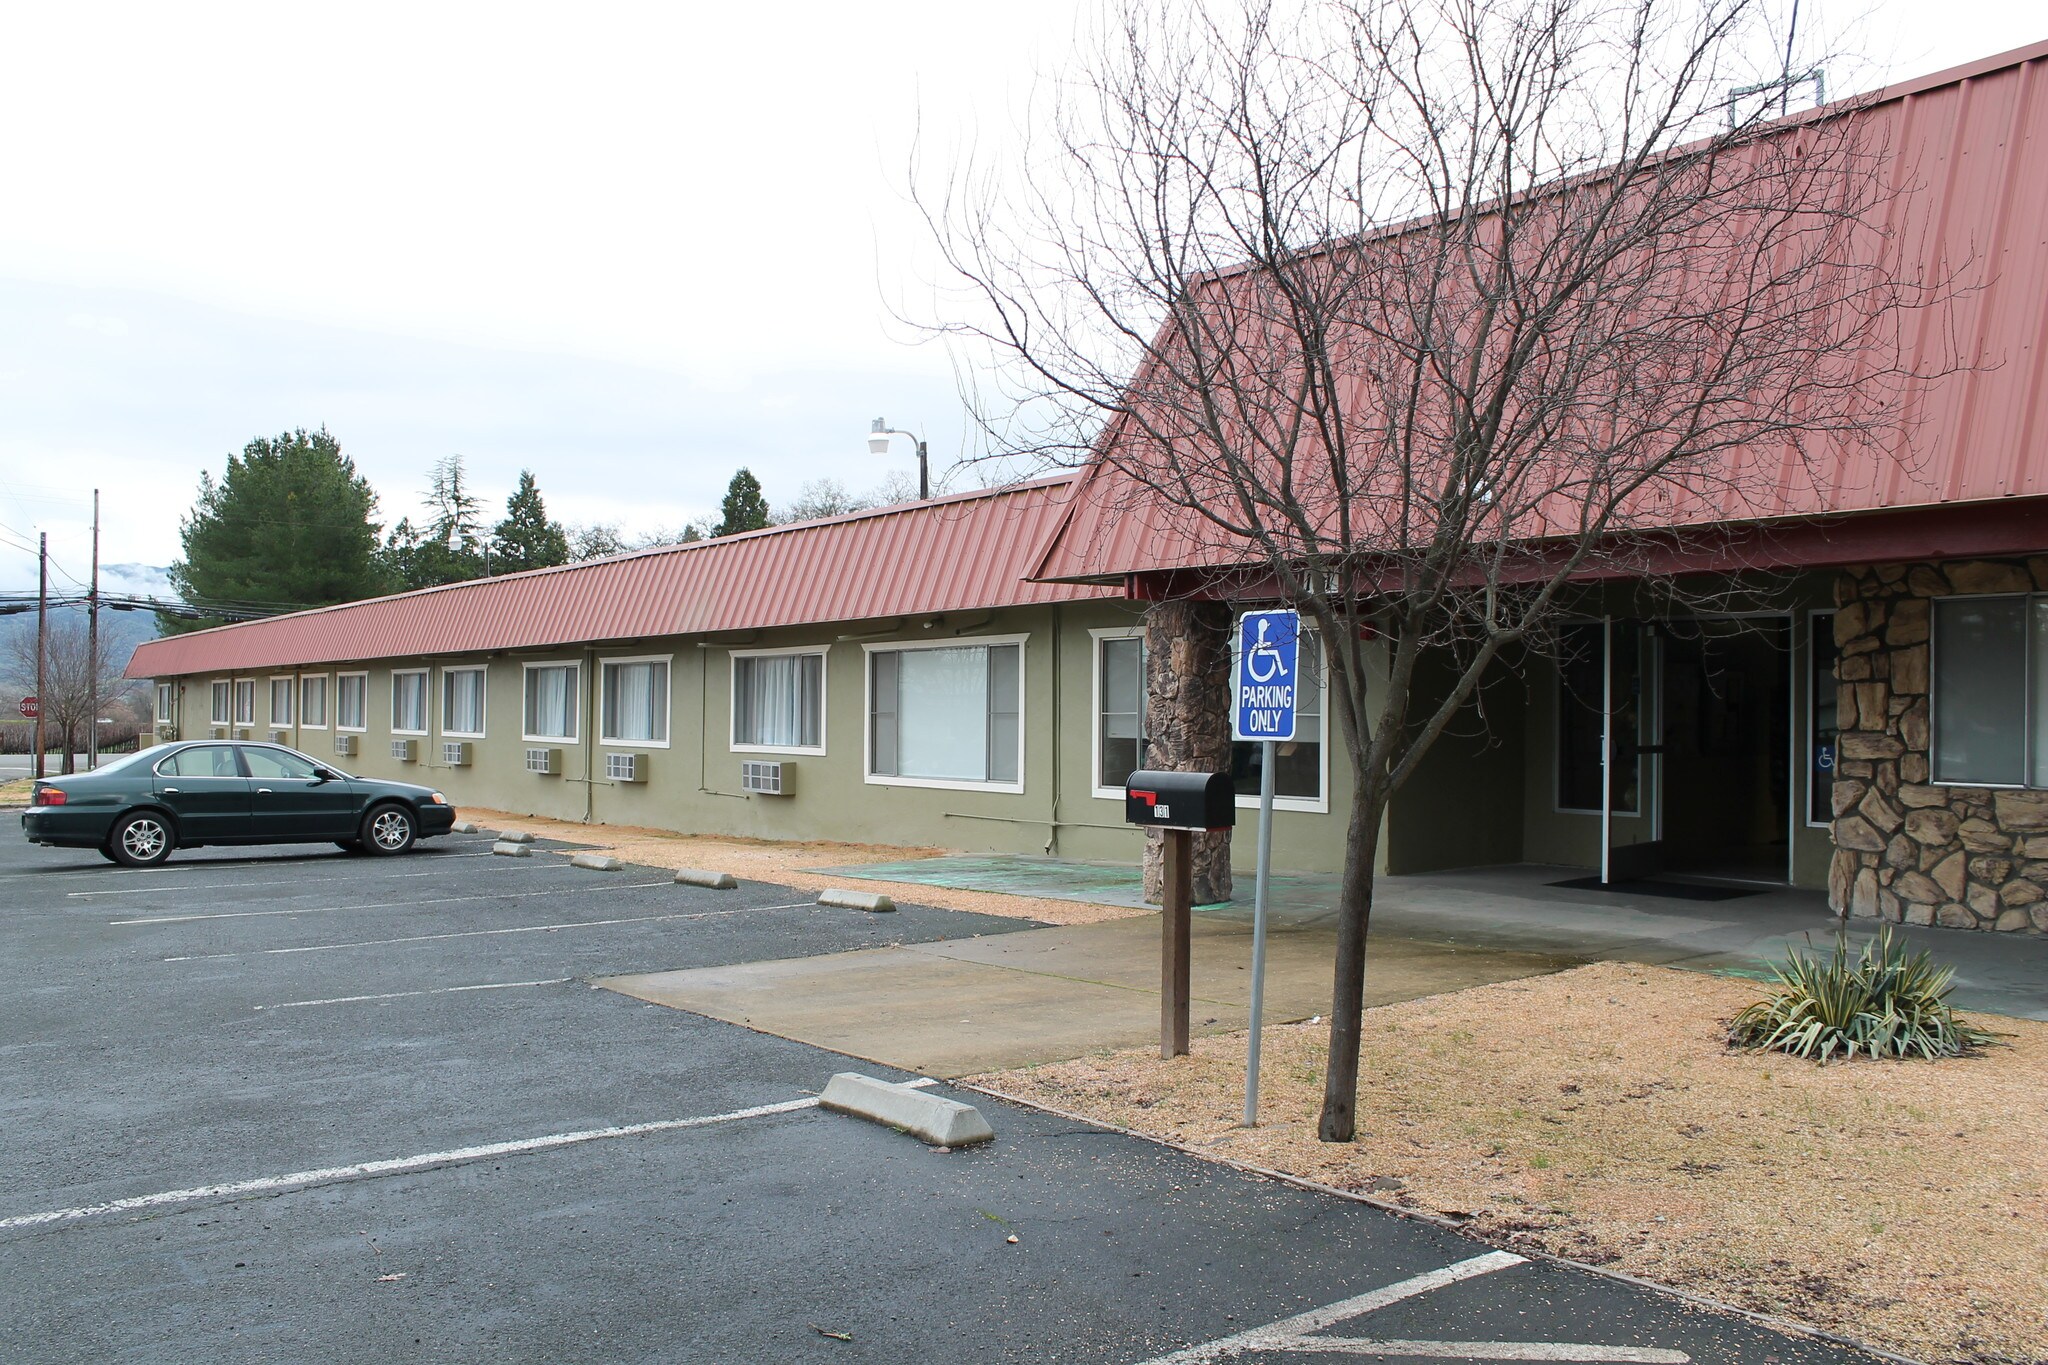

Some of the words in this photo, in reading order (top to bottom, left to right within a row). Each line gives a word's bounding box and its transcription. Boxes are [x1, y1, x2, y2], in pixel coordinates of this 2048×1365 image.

[1241, 685, 1292, 708] PARKING
[1249, 709, 1282, 732] ONLY
[1155, 805, 1169, 818] 131
